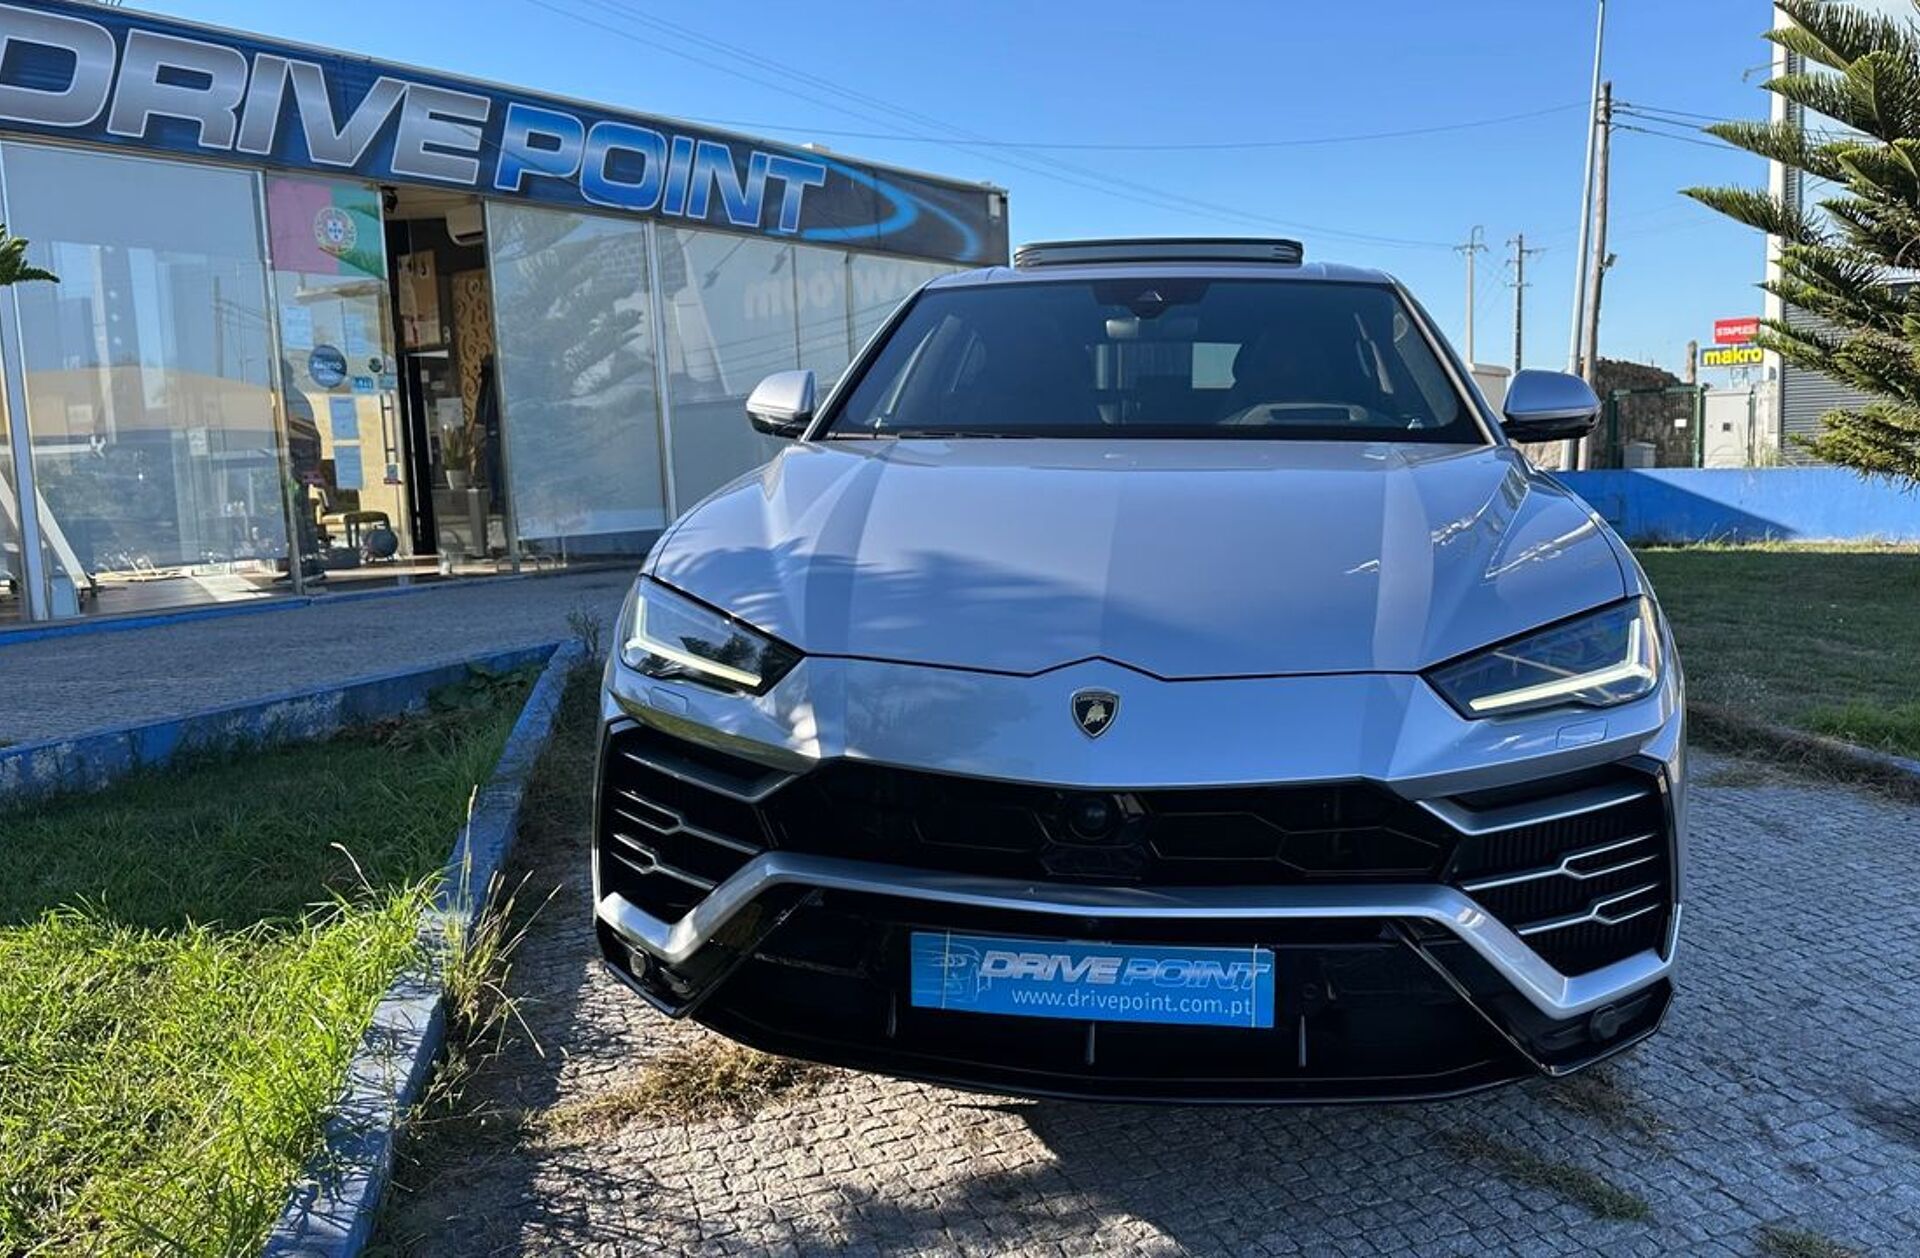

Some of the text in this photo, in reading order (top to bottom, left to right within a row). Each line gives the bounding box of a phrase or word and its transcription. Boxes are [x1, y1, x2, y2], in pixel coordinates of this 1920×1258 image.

[0, 5, 828, 234] DRIVE POINT
[1703, 346, 1762, 365] makro
[981, 949, 1272, 992] DRIVE POINT
[1011, 988, 1254, 1018] www.drivepoint.com.pt
